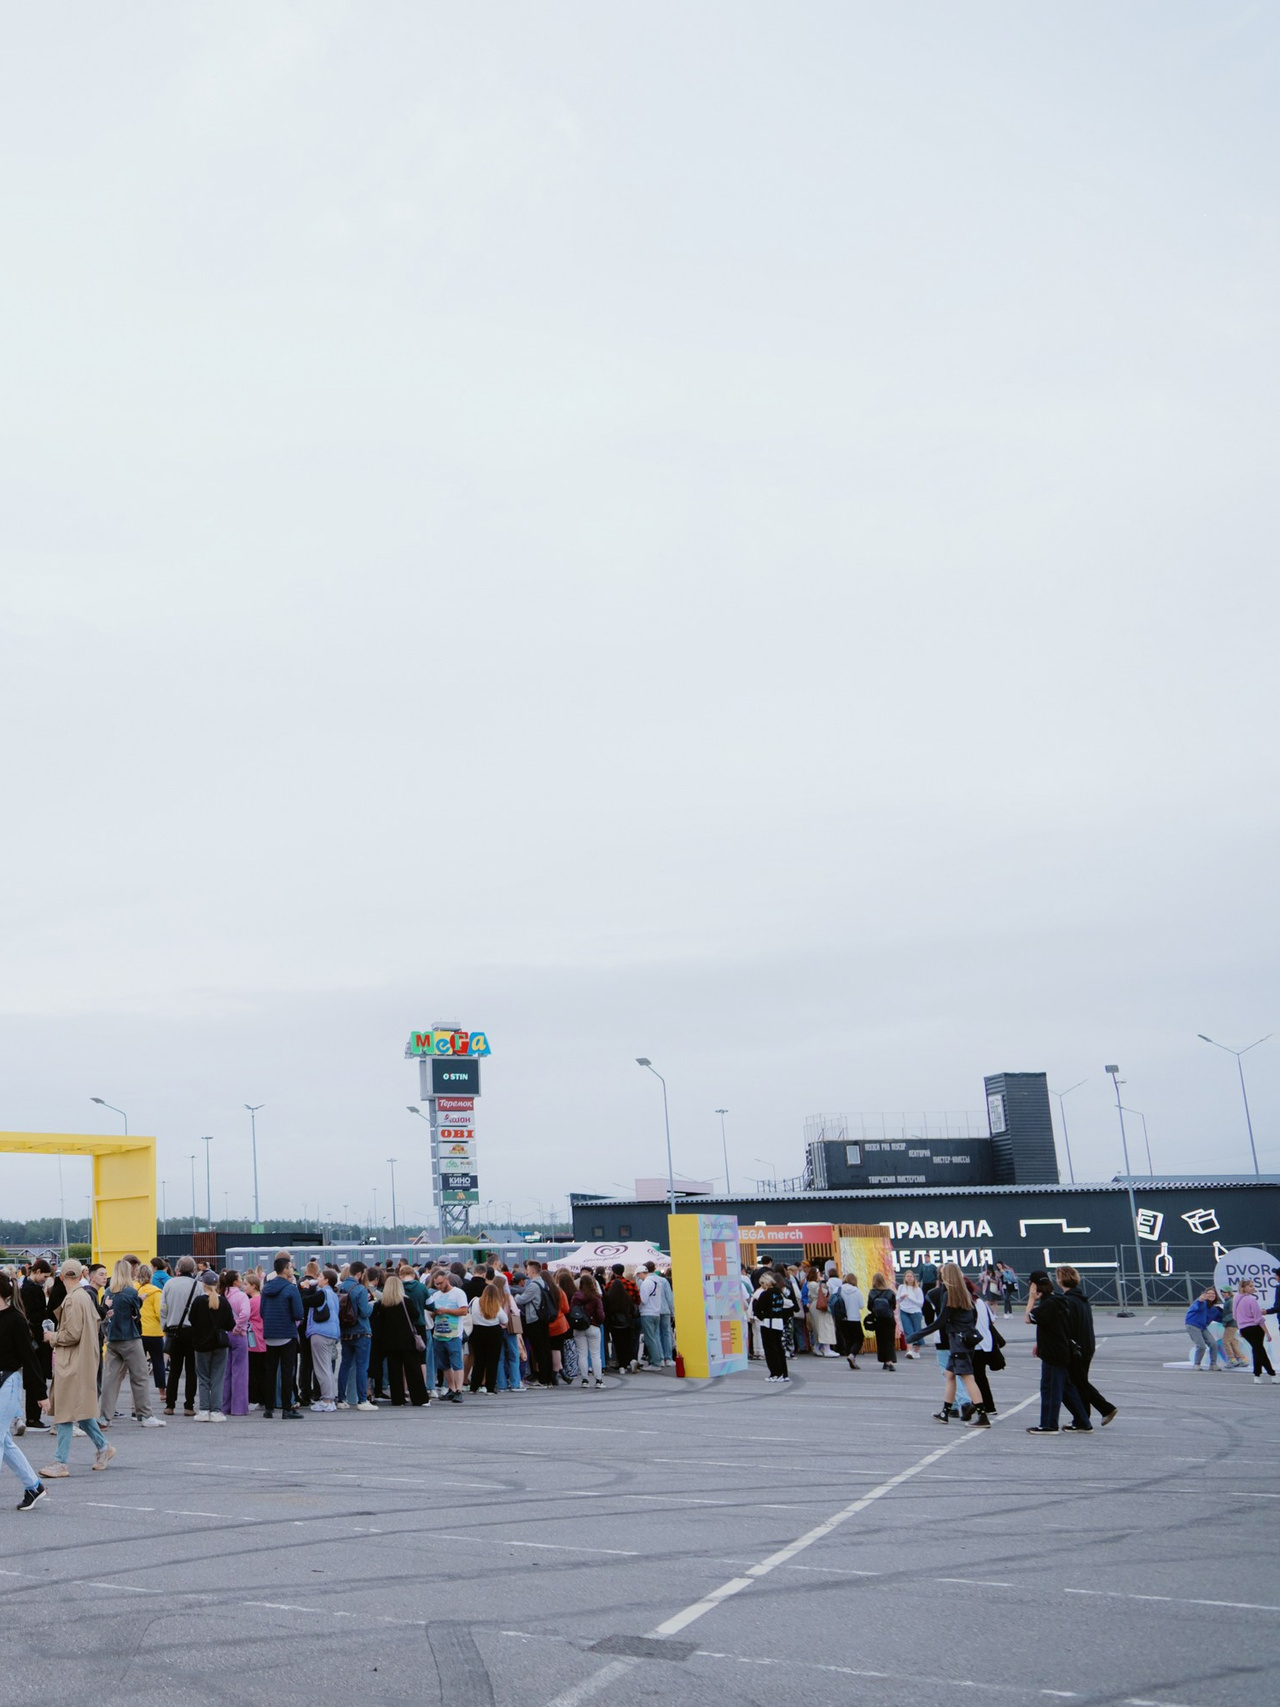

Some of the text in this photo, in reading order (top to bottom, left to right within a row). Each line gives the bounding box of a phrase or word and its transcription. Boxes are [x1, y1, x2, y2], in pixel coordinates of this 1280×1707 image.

[439, 1100, 472, 1108] Теремок
[440, 1129, 474, 1138] OBI
[768, 1229, 803, 1239] merch
[1226, 1264, 1271, 1276] DVOR
[1228, 1277, 1278, 1288] MSIC
